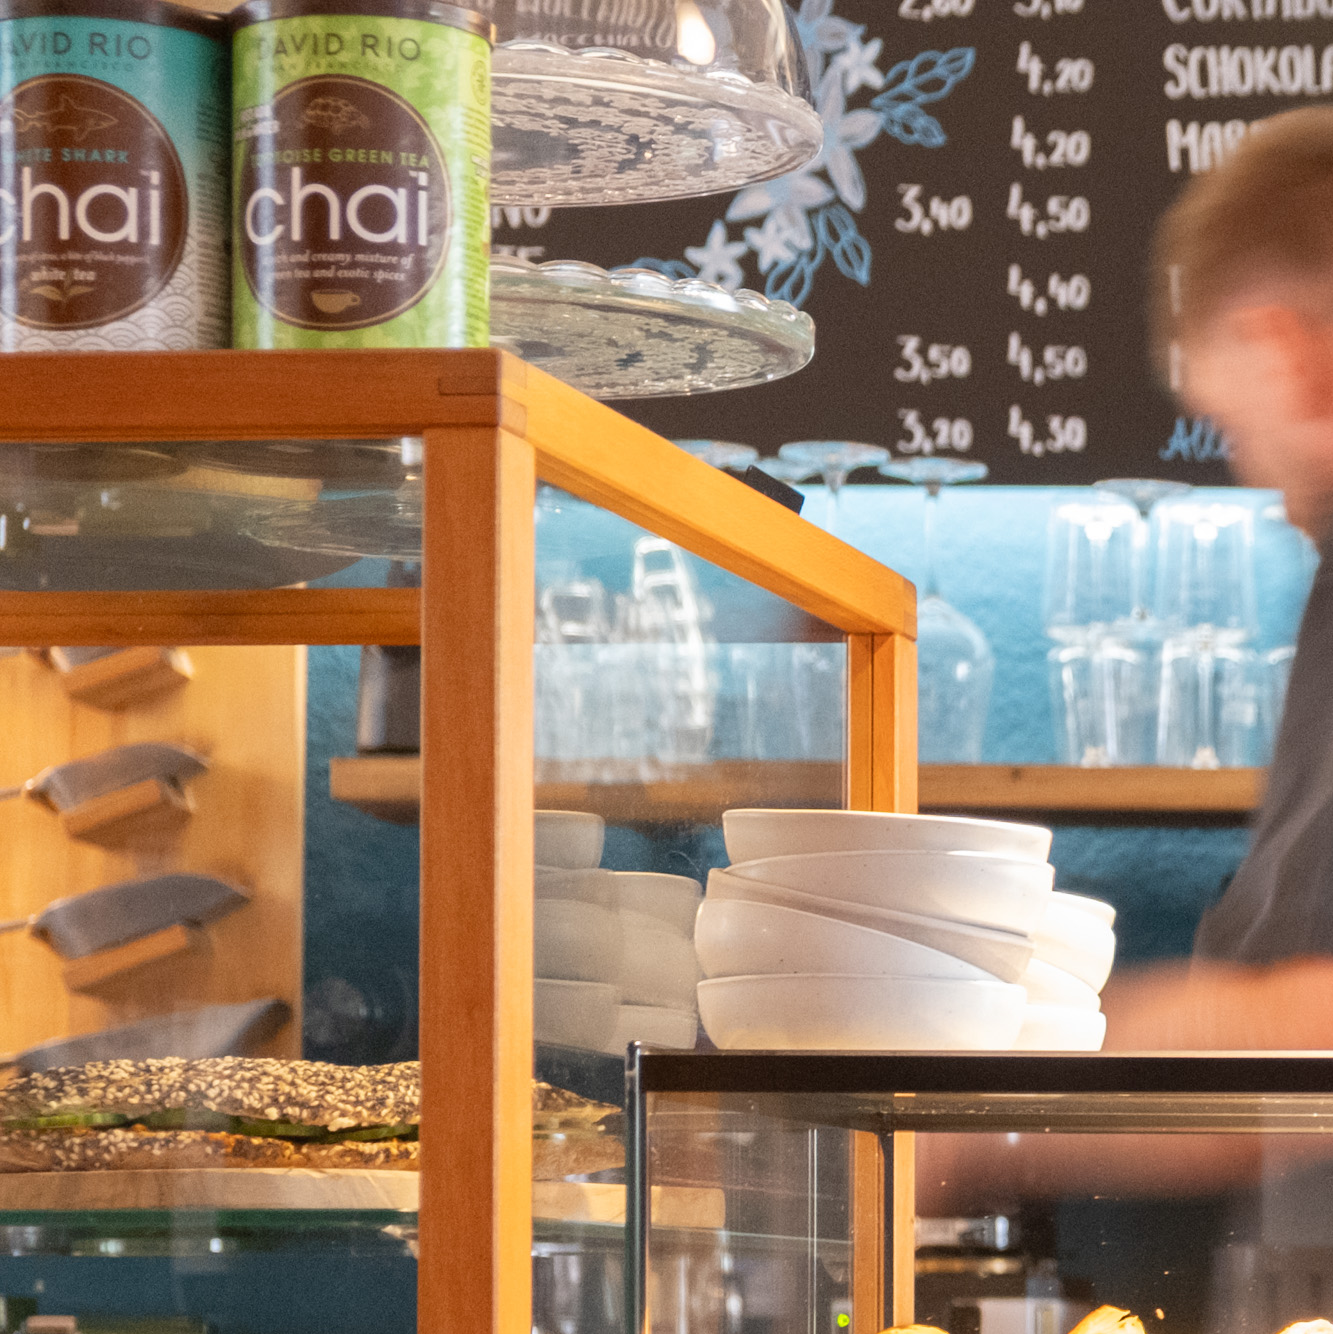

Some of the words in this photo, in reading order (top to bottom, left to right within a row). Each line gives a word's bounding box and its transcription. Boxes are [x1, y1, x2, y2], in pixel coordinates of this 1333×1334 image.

[87, 31, 151, 61] RIO
[361, 33, 421, 61] RIO
[61, 147, 129, 164] SHARK
[328, 148, 394, 165] GREEN
[400, 150, 430, 168] TEA
[245, 166, 429, 247] chai
